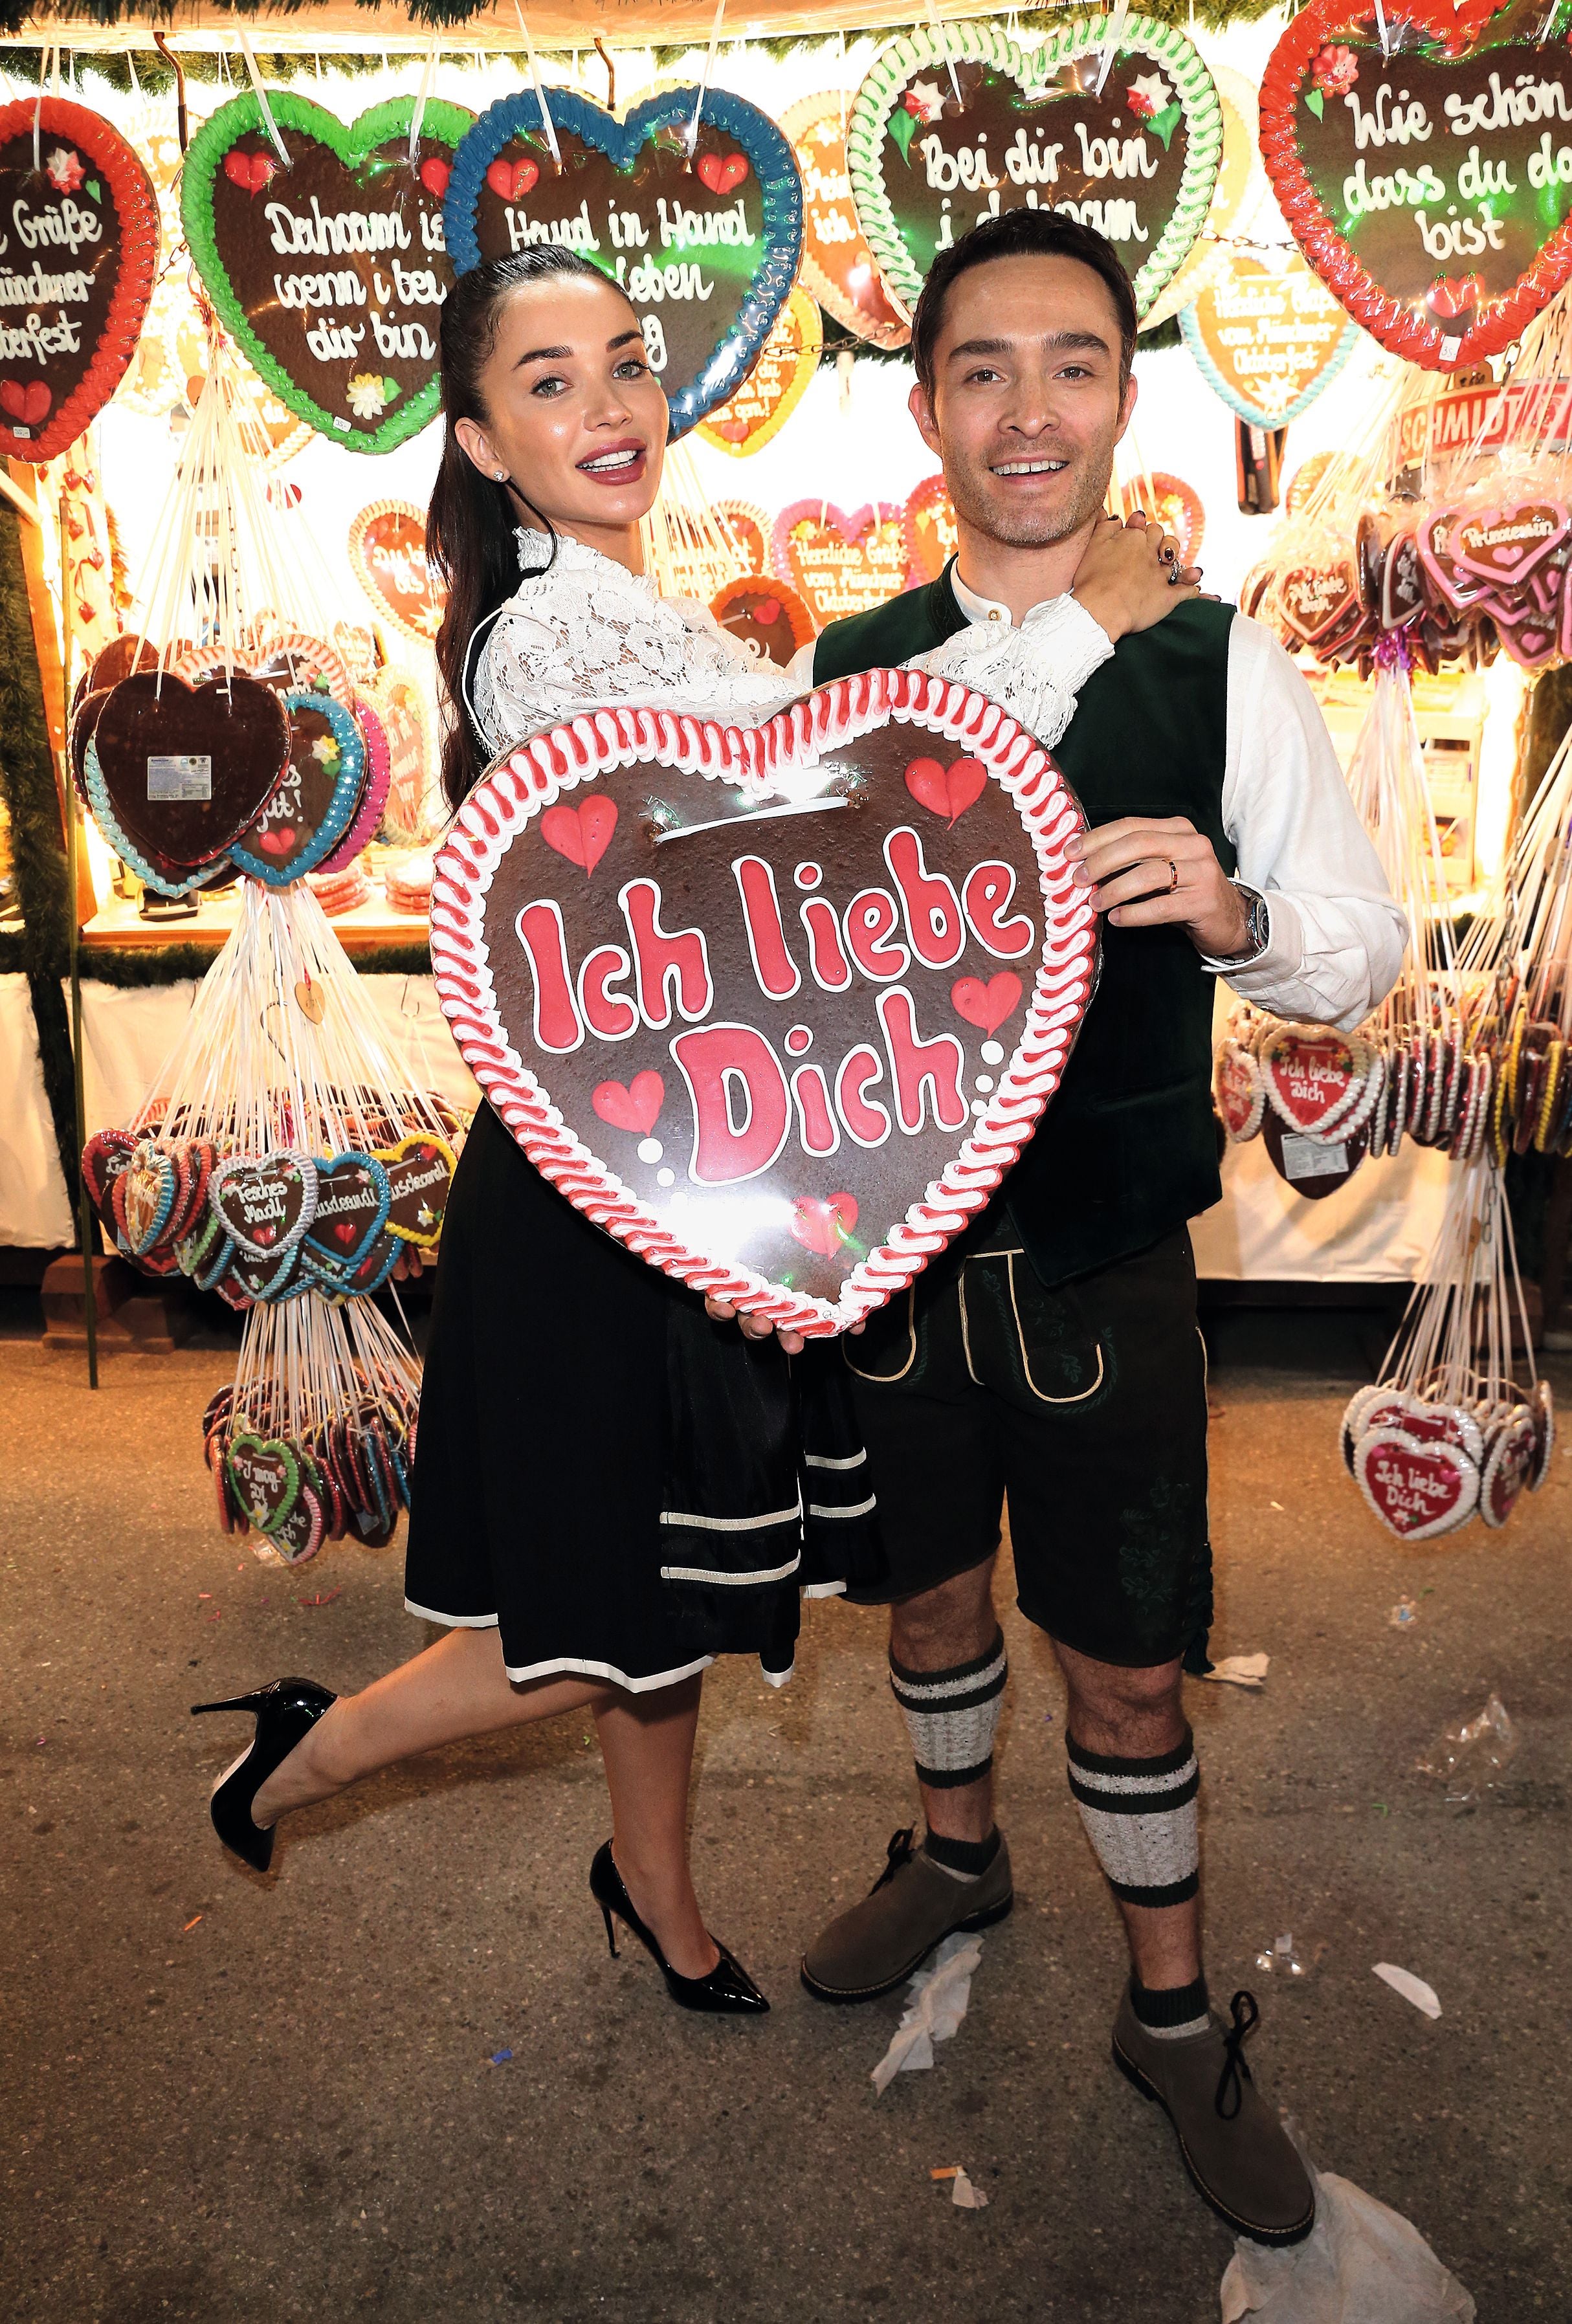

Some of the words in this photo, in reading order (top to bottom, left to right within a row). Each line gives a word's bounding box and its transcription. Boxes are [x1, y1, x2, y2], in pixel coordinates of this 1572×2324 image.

[1344, 82, 1434, 149] Wie
[1443, 71, 1572, 136] schön
[919, 133, 1000, 192] Bei
[1004, 127, 1064, 185] dir
[1074, 117, 1160, 179] bin
[1342, 158, 1446, 215] dass
[1457, 145, 1518, 200] du
[12, 198, 103, 255] Grüße
[608, 199, 650, 249] in
[656, 197, 757, 248] Hand
[1414, 201, 1507, 261] bist
[0, 260, 96, 307] ünchner
[273, 269, 367, 309] wenn
[370, 255, 392, 305] i
[391, 258, 448, 306] bei
[0, 309, 82, 366] berfest
[305, 316, 366, 362] dir
[369, 310, 437, 360] bin
[261, 399, 290, 425] du
[1400, 393, 1522, 453] SCHMIDT
[803, 571, 837, 588] vom
[515, 877, 715, 1056] Ich
[731, 825, 1036, 1002] liebe
[669, 984, 969, 1188] Dich
[1279, 1056, 1305, 1079] Ich
[1308, 1056, 1346, 1087] liebe
[1290, 1080, 1325, 1104] Dich
[243, 1196, 287, 1224] Madl
[252, 1466, 282, 1494] mog
[1374, 1460, 1406, 1487] Ich
[1408, 1467, 1453, 1499] liebe
[1386, 1484, 1437, 1516] Dich
